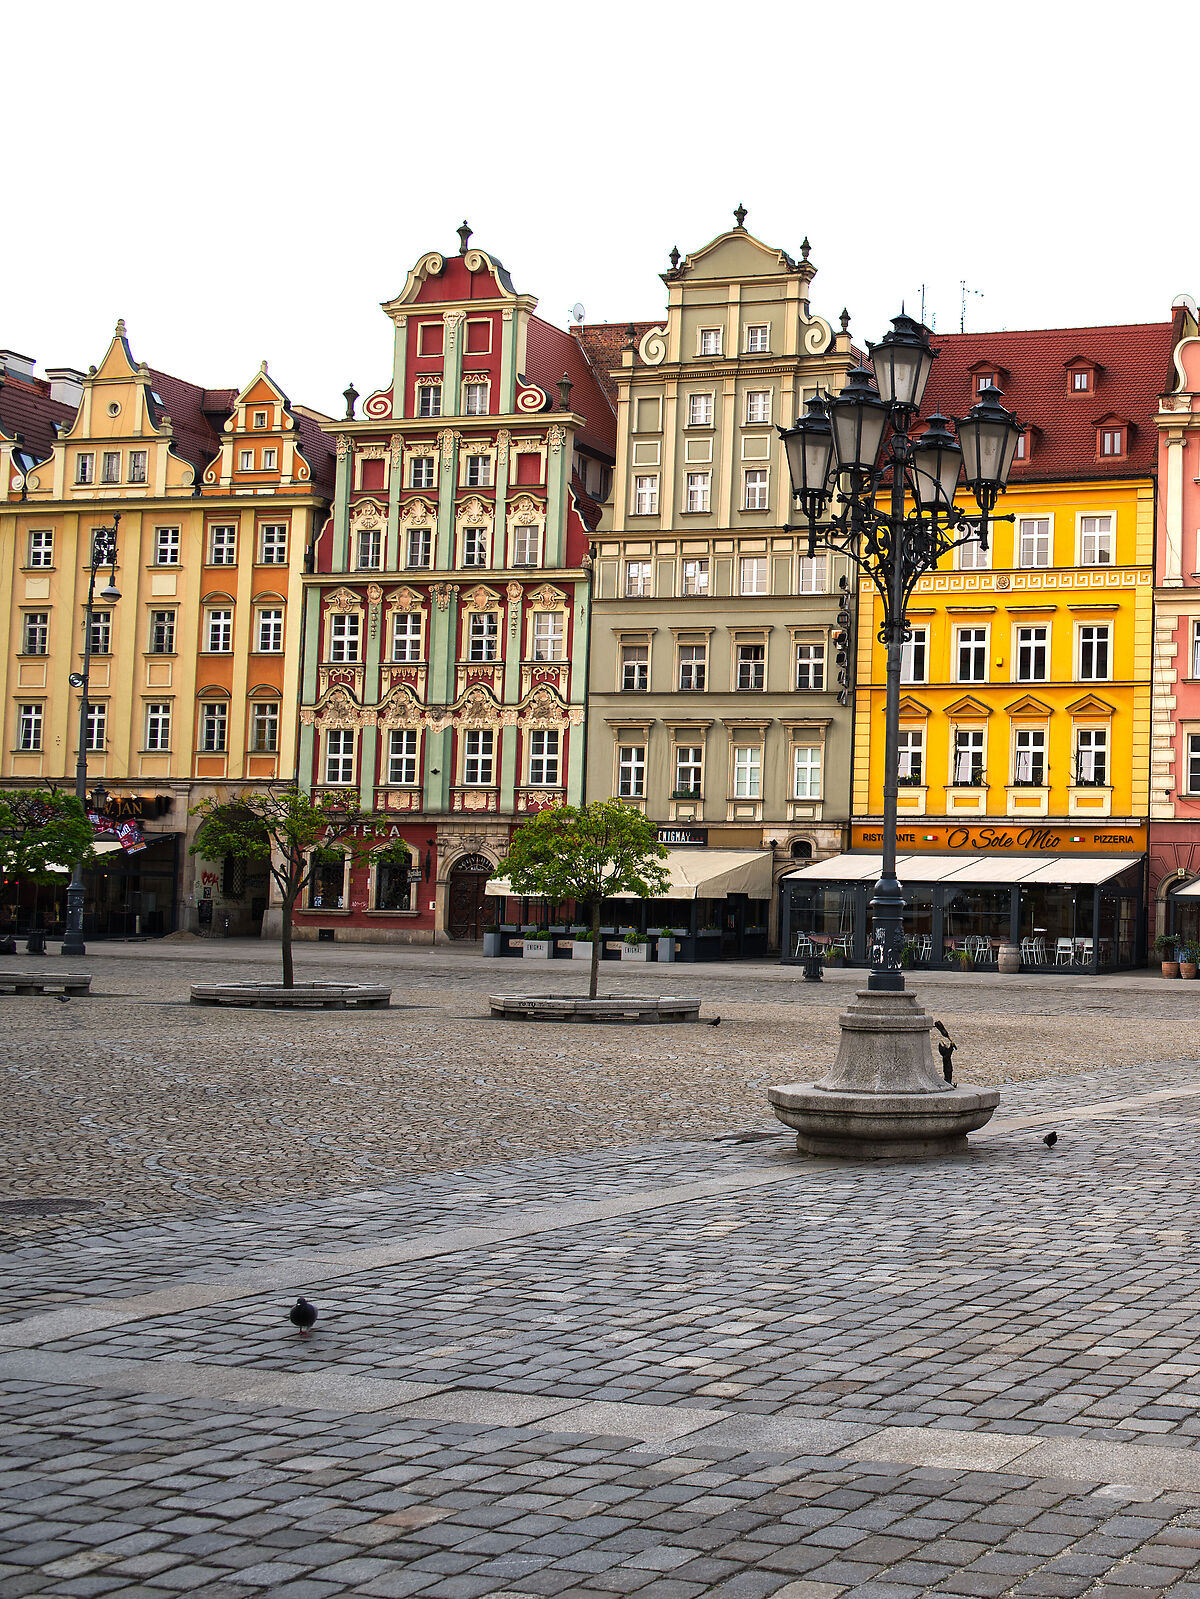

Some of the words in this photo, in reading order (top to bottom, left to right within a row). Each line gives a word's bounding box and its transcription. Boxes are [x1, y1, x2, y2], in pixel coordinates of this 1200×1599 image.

[117, 801, 142, 817] JAN
[972, 828, 1014, 848] Sole
[1016, 828, 1062, 849] Mio
[1093, 835, 1134, 844] PIZZERIA
